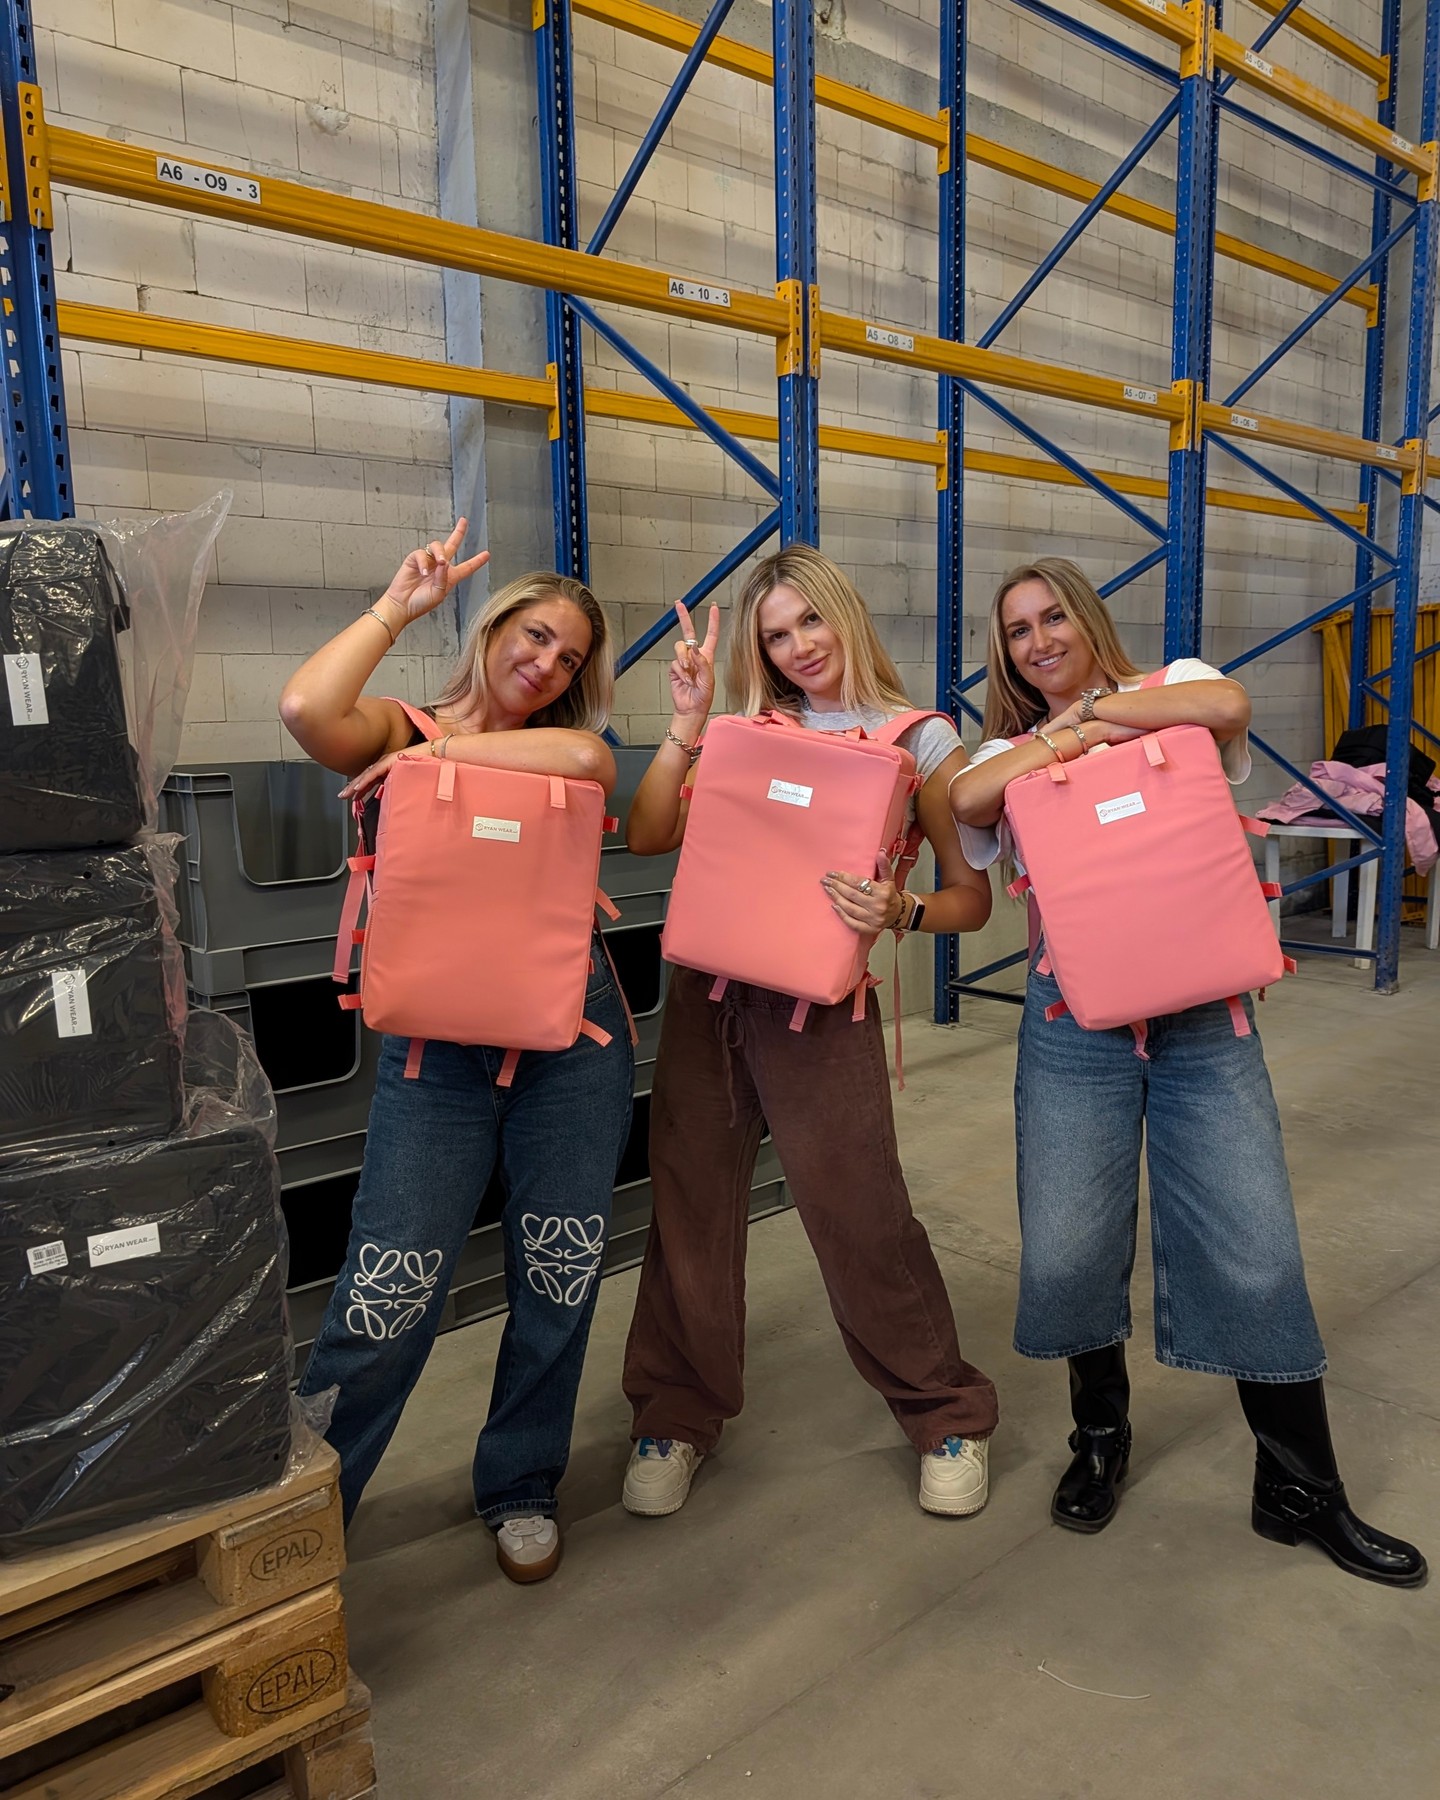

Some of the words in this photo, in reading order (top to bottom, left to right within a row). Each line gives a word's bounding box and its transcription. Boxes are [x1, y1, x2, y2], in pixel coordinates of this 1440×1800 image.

[160, 162, 183, 181] A6
[248, 184, 258, 199] 3
[670, 281, 685, 295] A6
[698, 287, 710, 300] 10
[722, 292, 729, 304] 3
[867, 329, 879, 341] A5
[908, 339, 913, 349] 3
[20, 669, 30, 690] RYAN
[105, 1242, 125, 1251] RYAN
[262, 1536, 315, 1575] EPAL
[260, 1657, 325, 1708] EPAL
